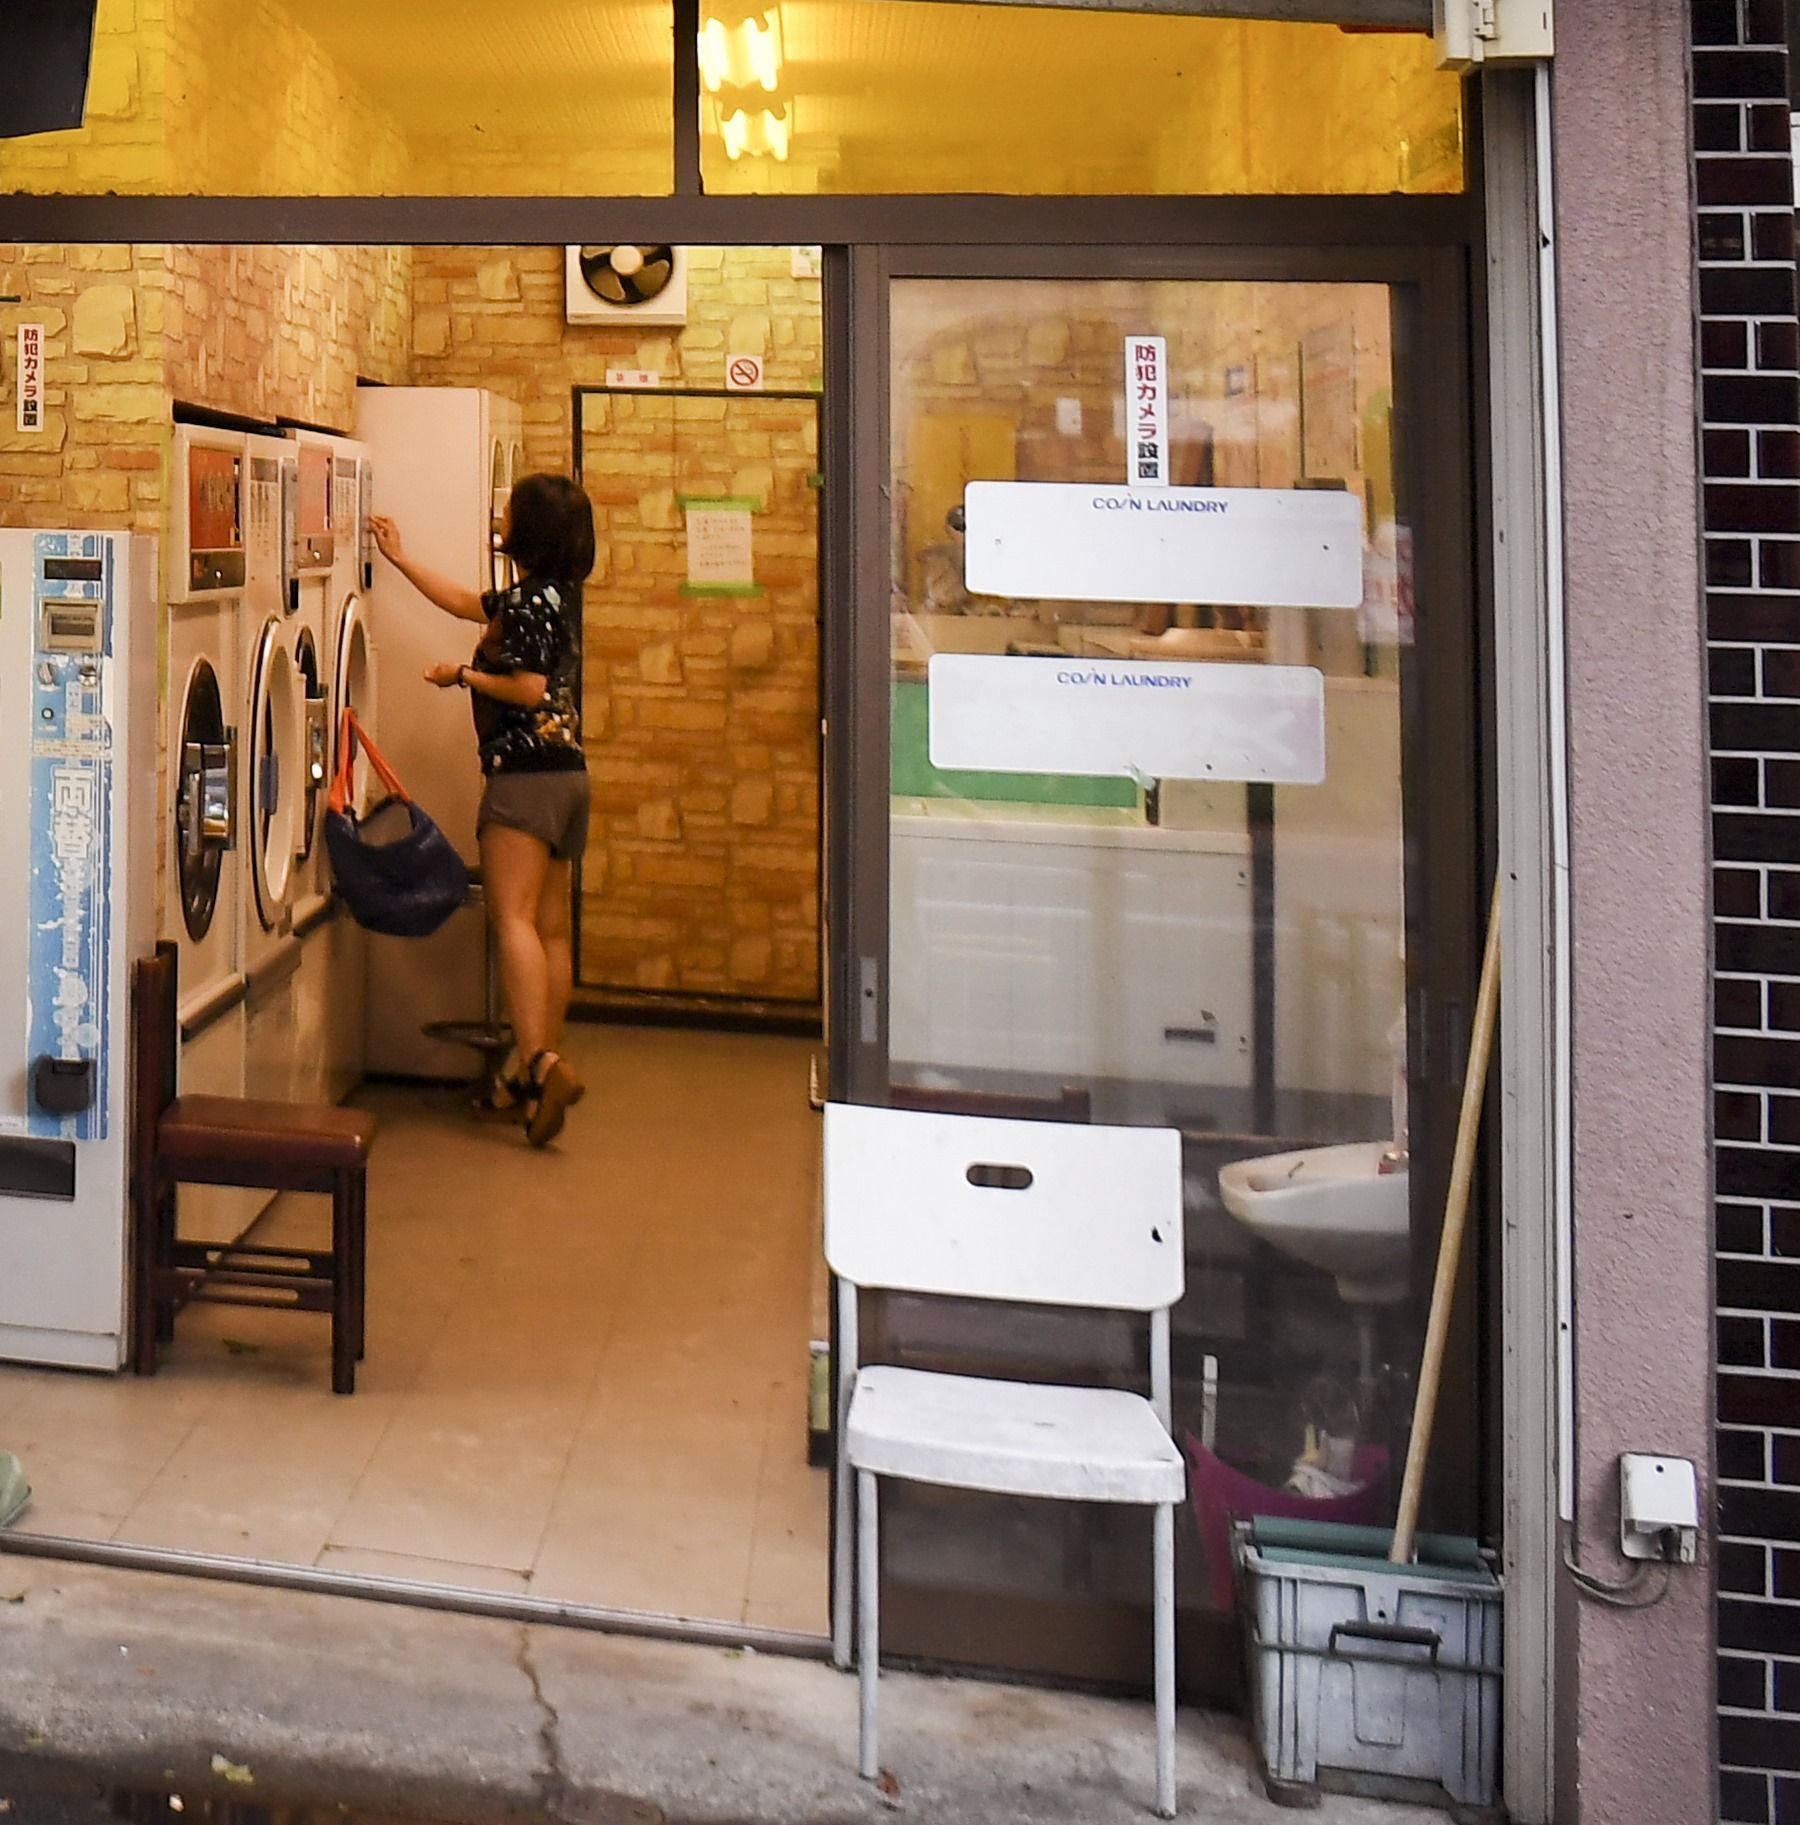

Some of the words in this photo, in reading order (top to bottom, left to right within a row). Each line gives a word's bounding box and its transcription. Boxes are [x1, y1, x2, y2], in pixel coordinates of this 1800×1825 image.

[23, 328, 38, 426] 防犯カメラ設置
[1134, 343, 1159, 479] 防犯カメラ設置
[1147, 498, 1229, 514] LAUNDRY
[1111, 672, 1193, 689] LAUNDRY
